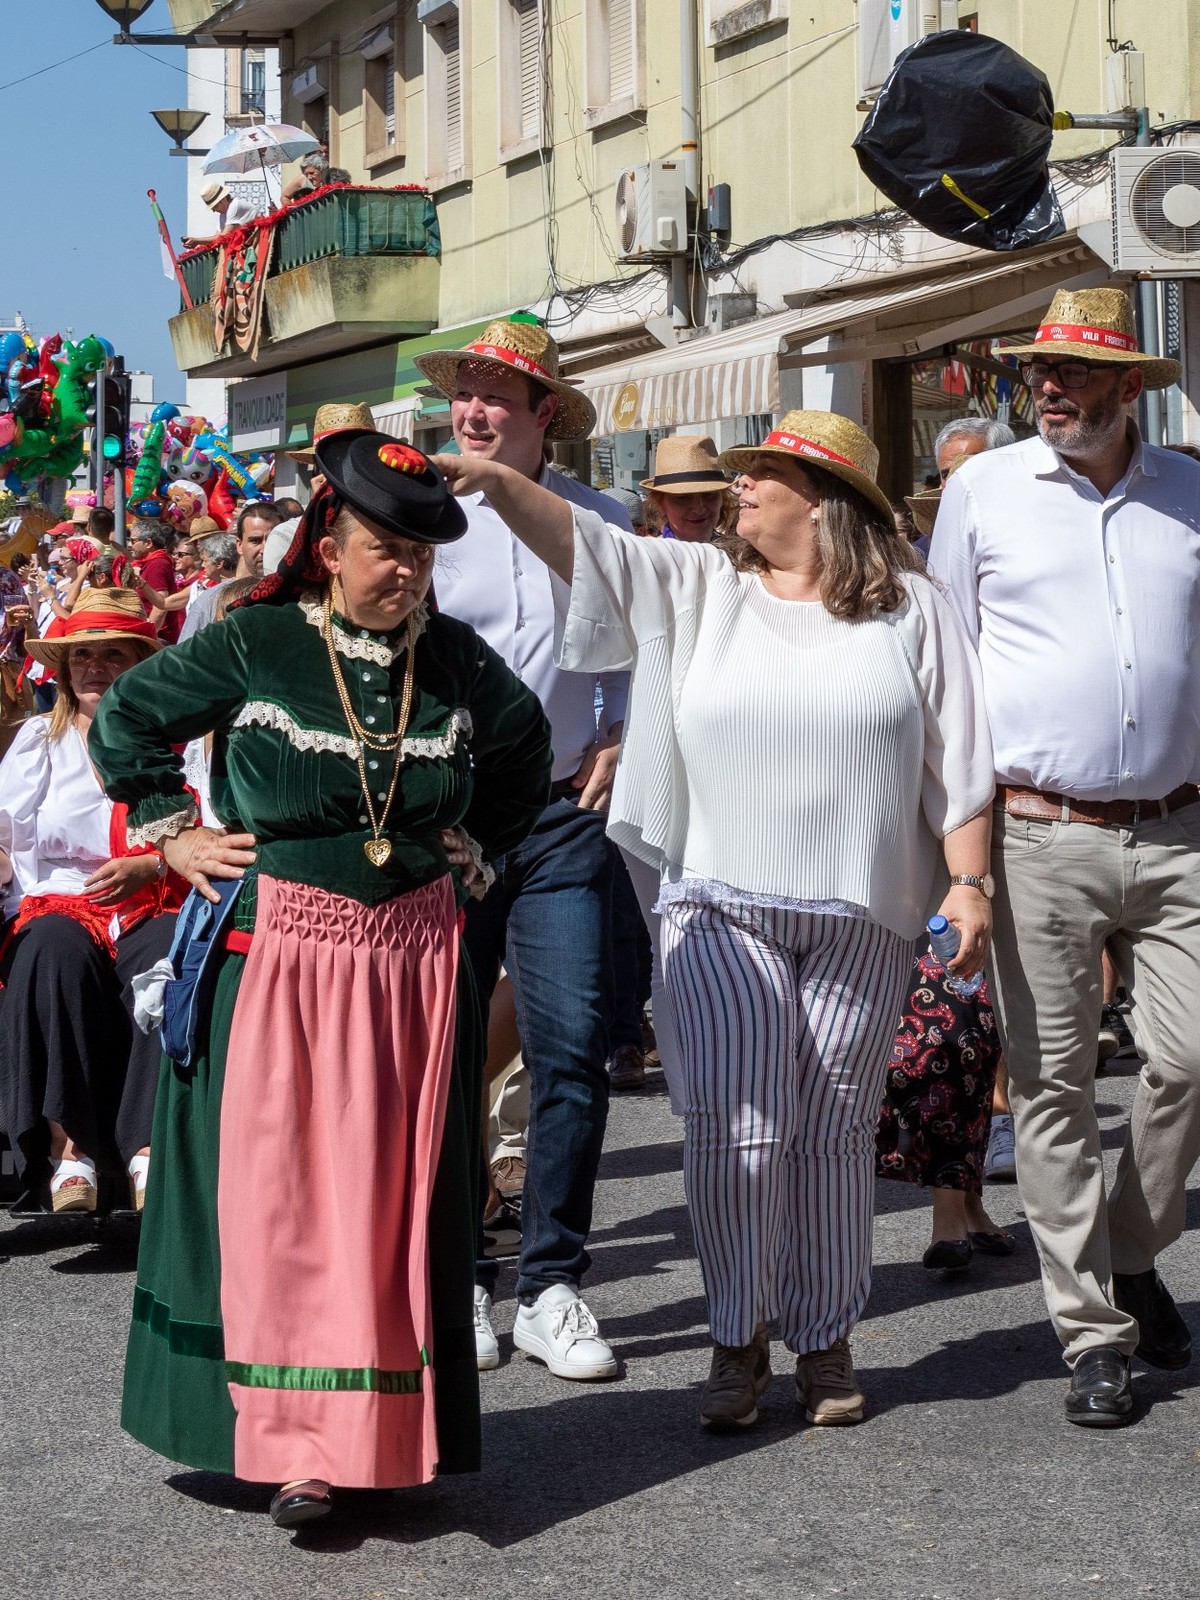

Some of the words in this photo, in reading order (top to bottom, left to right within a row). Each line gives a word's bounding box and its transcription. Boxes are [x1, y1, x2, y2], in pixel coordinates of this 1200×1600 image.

[1082, 331, 1100, 342] VILA
[235, 392, 285, 430] TRANQUILIDADE
[779, 436, 796, 448] VILA
